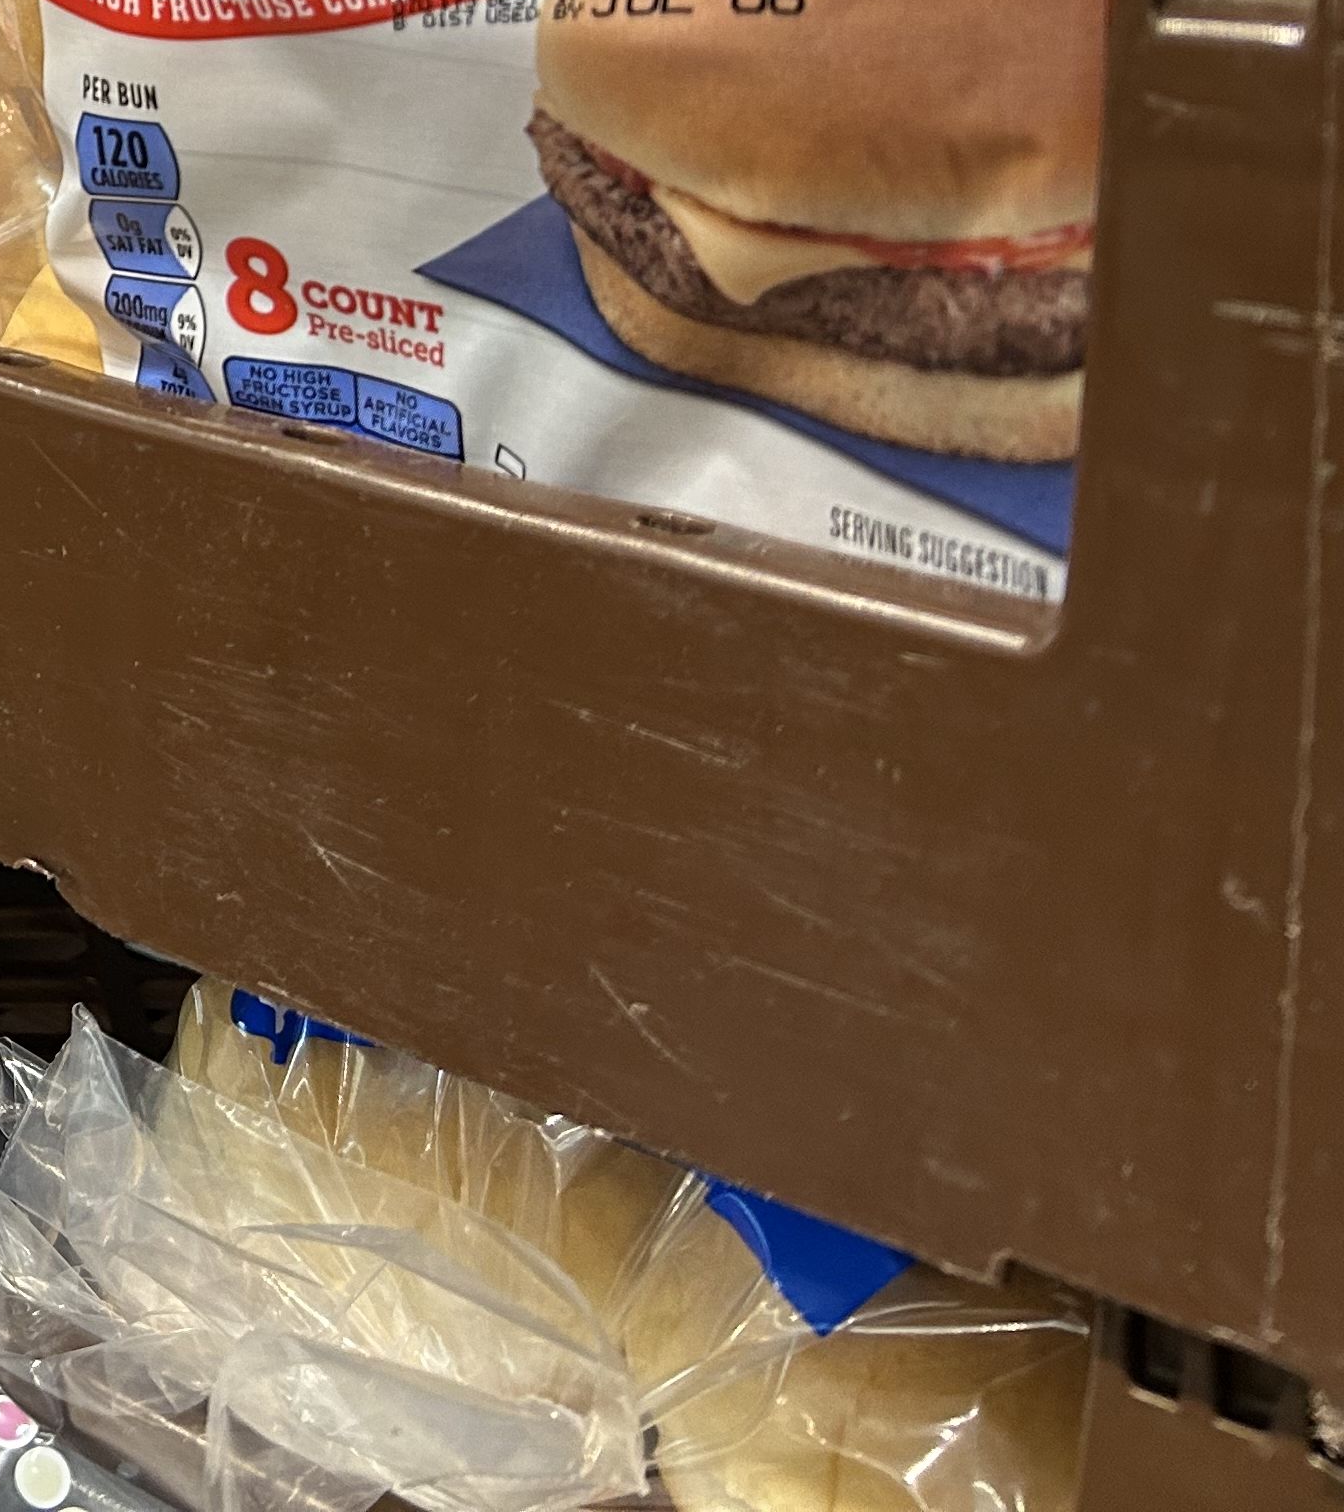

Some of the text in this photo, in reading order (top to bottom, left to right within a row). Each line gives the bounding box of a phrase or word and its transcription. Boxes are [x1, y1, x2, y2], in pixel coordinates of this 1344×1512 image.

[422, 9, 475, 29] 0157
[485, 5, 539, 25] USED
[83, 73, 158, 110] PER BUN
[93, 125, 149, 169] 120
[91, 167, 163, 190] CALORIES
[117, 213, 190, 242] 0g 0%
[107, 234, 133, 253] SAT
[139, 238, 163, 256] FAT
[225, 236, 444, 335] 8 COUNT
[112, 291, 168, 327] 200mg
[178, 313, 196, 331] 9%
[307, 312, 444, 368] Pre-sliced
[241, 378, 342, 401] FRUCTOSE
[249, 365, 331, 387] NO HIGH
[235, 390, 351, 419] CORN SYRUP
[364, 396, 452, 436] ARTIFICIAL
[395, 391, 417, 410] NO
[371, 414, 442, 449] FLAVORS
[830, 505, 1049, 599] SERVING SUGGESTION
